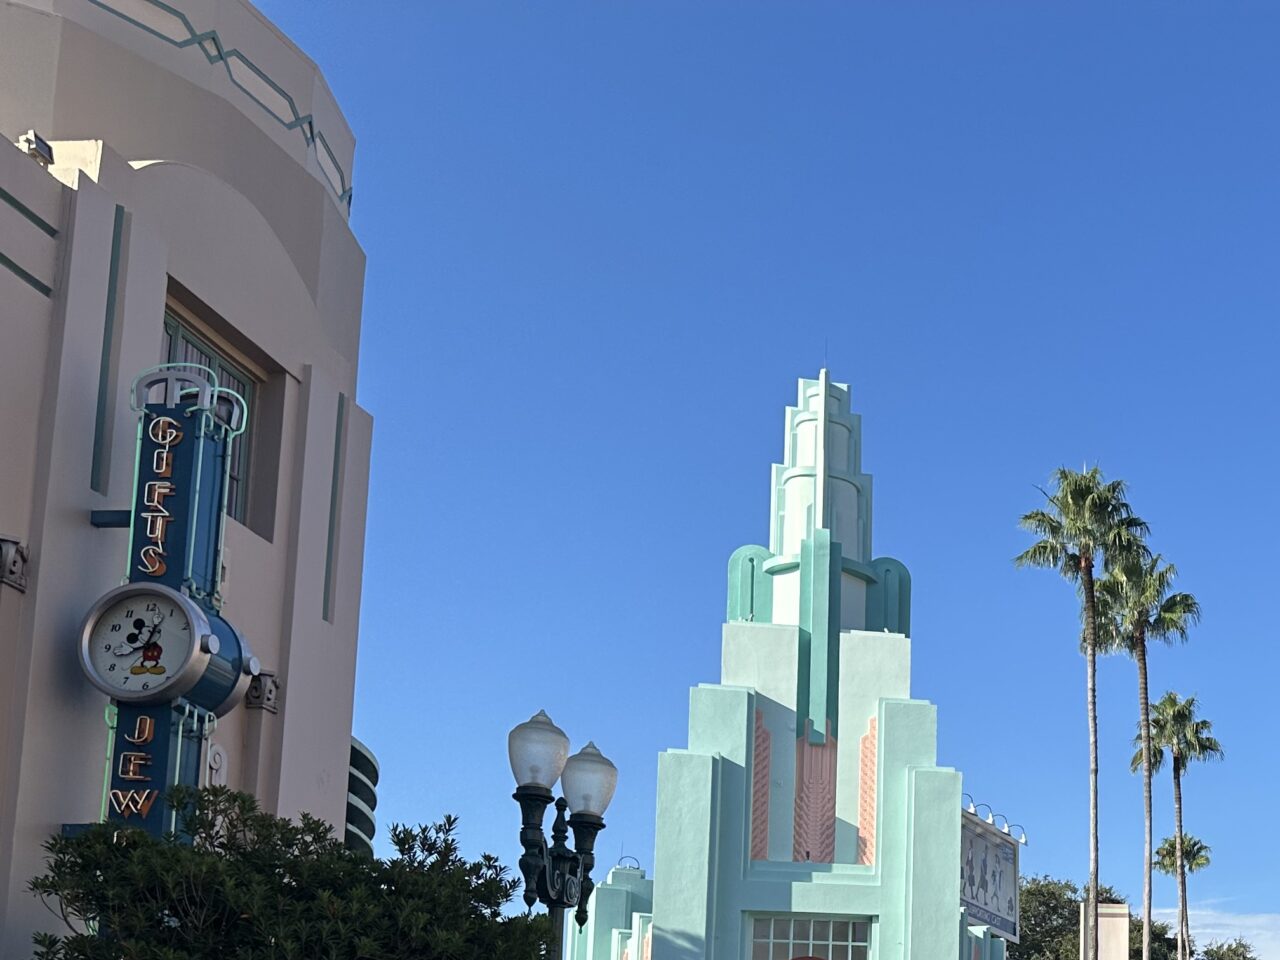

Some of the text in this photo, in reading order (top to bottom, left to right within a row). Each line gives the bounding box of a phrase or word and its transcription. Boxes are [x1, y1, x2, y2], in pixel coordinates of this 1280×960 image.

[138, 416, 184, 577] GIFTS
[145, 603, 157, 612] 12
[125, 610, 134, 618] 11
[169, 609, 174, 617] 1
[110, 624, 121, 632] 10
[104, 644, 111, 652] 9
[123, 677, 129, 685] 7
[142, 682, 149, 690] 6
[110, 715, 158, 847] JEW
